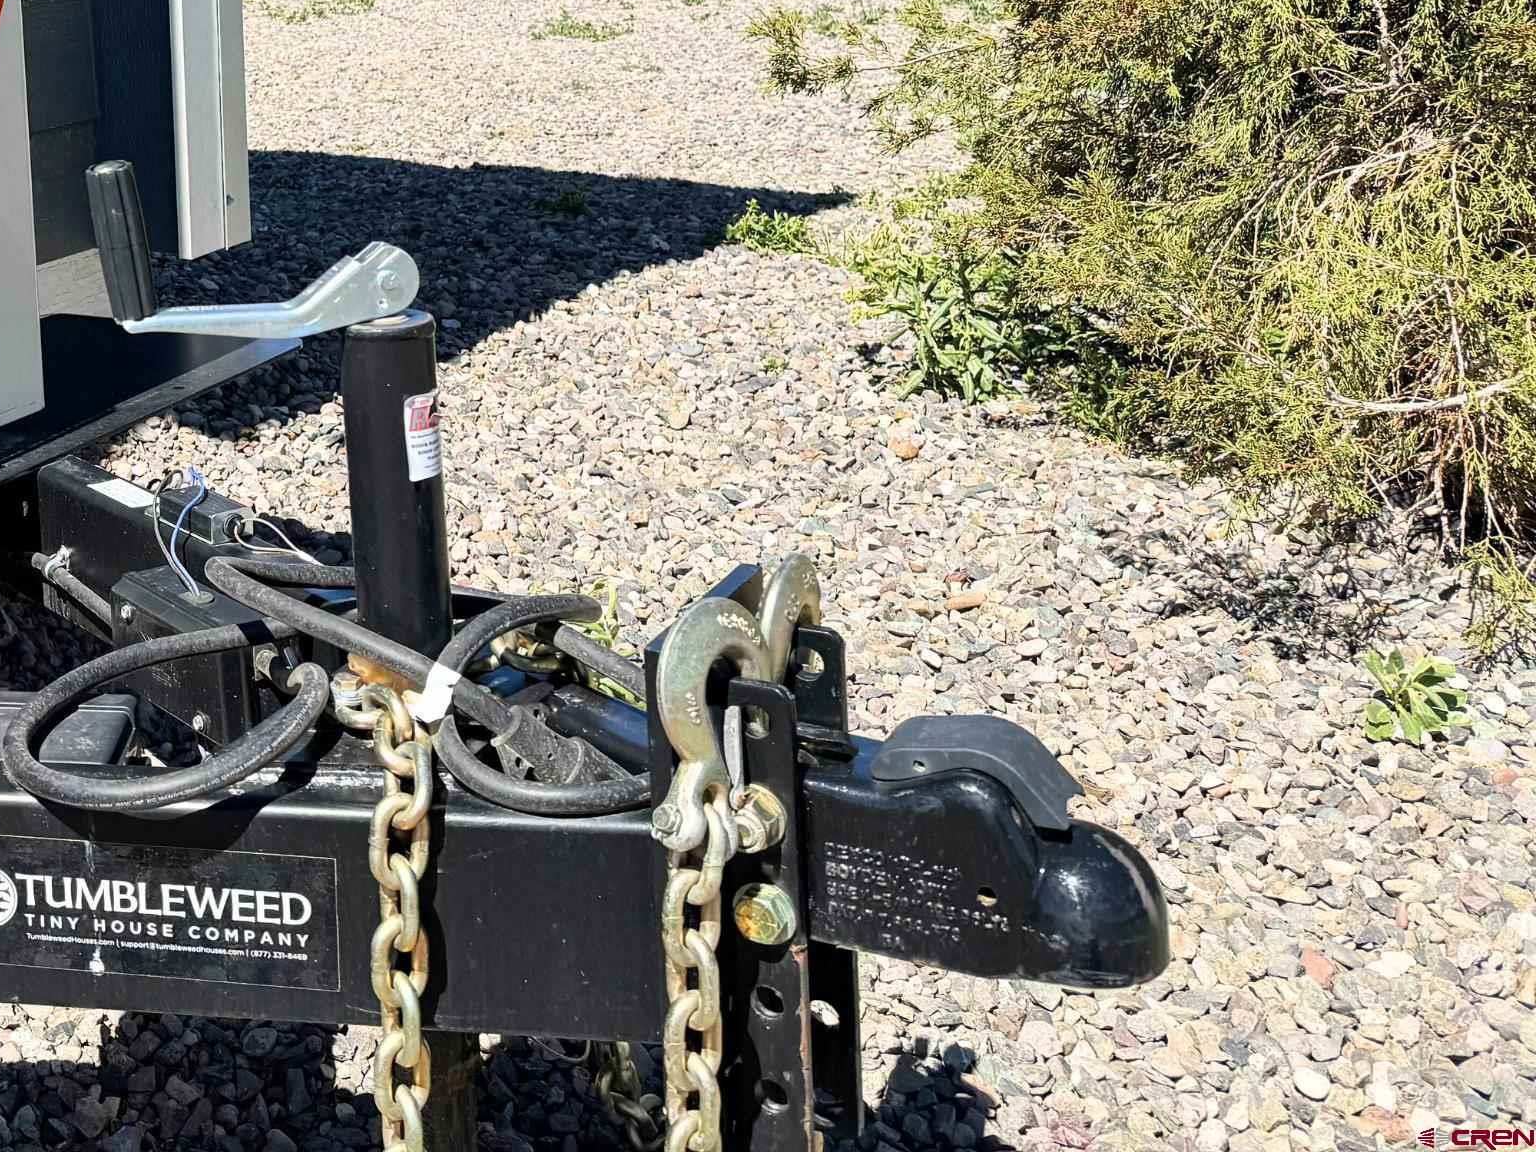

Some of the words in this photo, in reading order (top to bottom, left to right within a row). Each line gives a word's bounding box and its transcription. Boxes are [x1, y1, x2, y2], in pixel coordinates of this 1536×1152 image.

[15, 872, 313, 926] TUMBLEWEED
[24, 913, 80, 930] TINY
[93, 919, 174, 938] HOUSE
[188, 924, 311, 949] COMPANY
